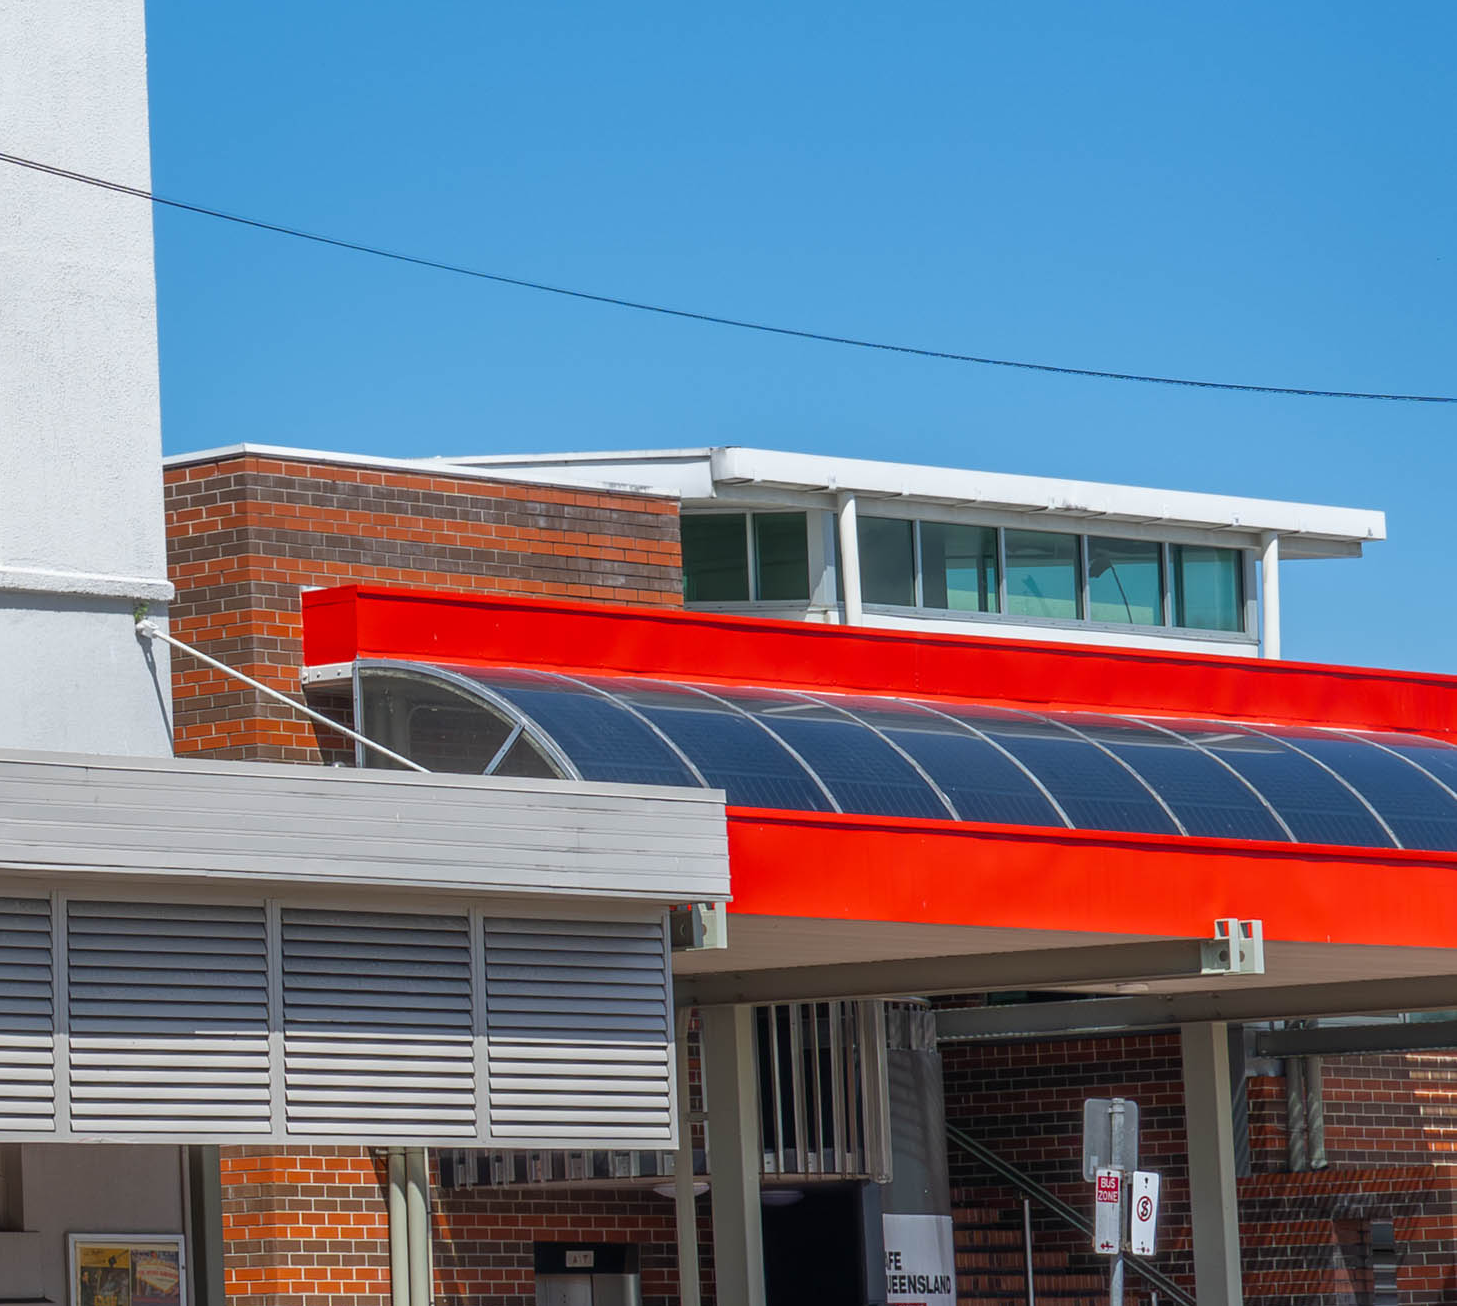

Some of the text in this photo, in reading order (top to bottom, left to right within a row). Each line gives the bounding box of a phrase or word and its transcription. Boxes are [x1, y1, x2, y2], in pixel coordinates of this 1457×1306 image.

[1100, 1177, 1116, 1190] BUS
[1097, 1190, 1119, 1202] ZONE
[886, 1274, 952, 1295] UEENSLAND
